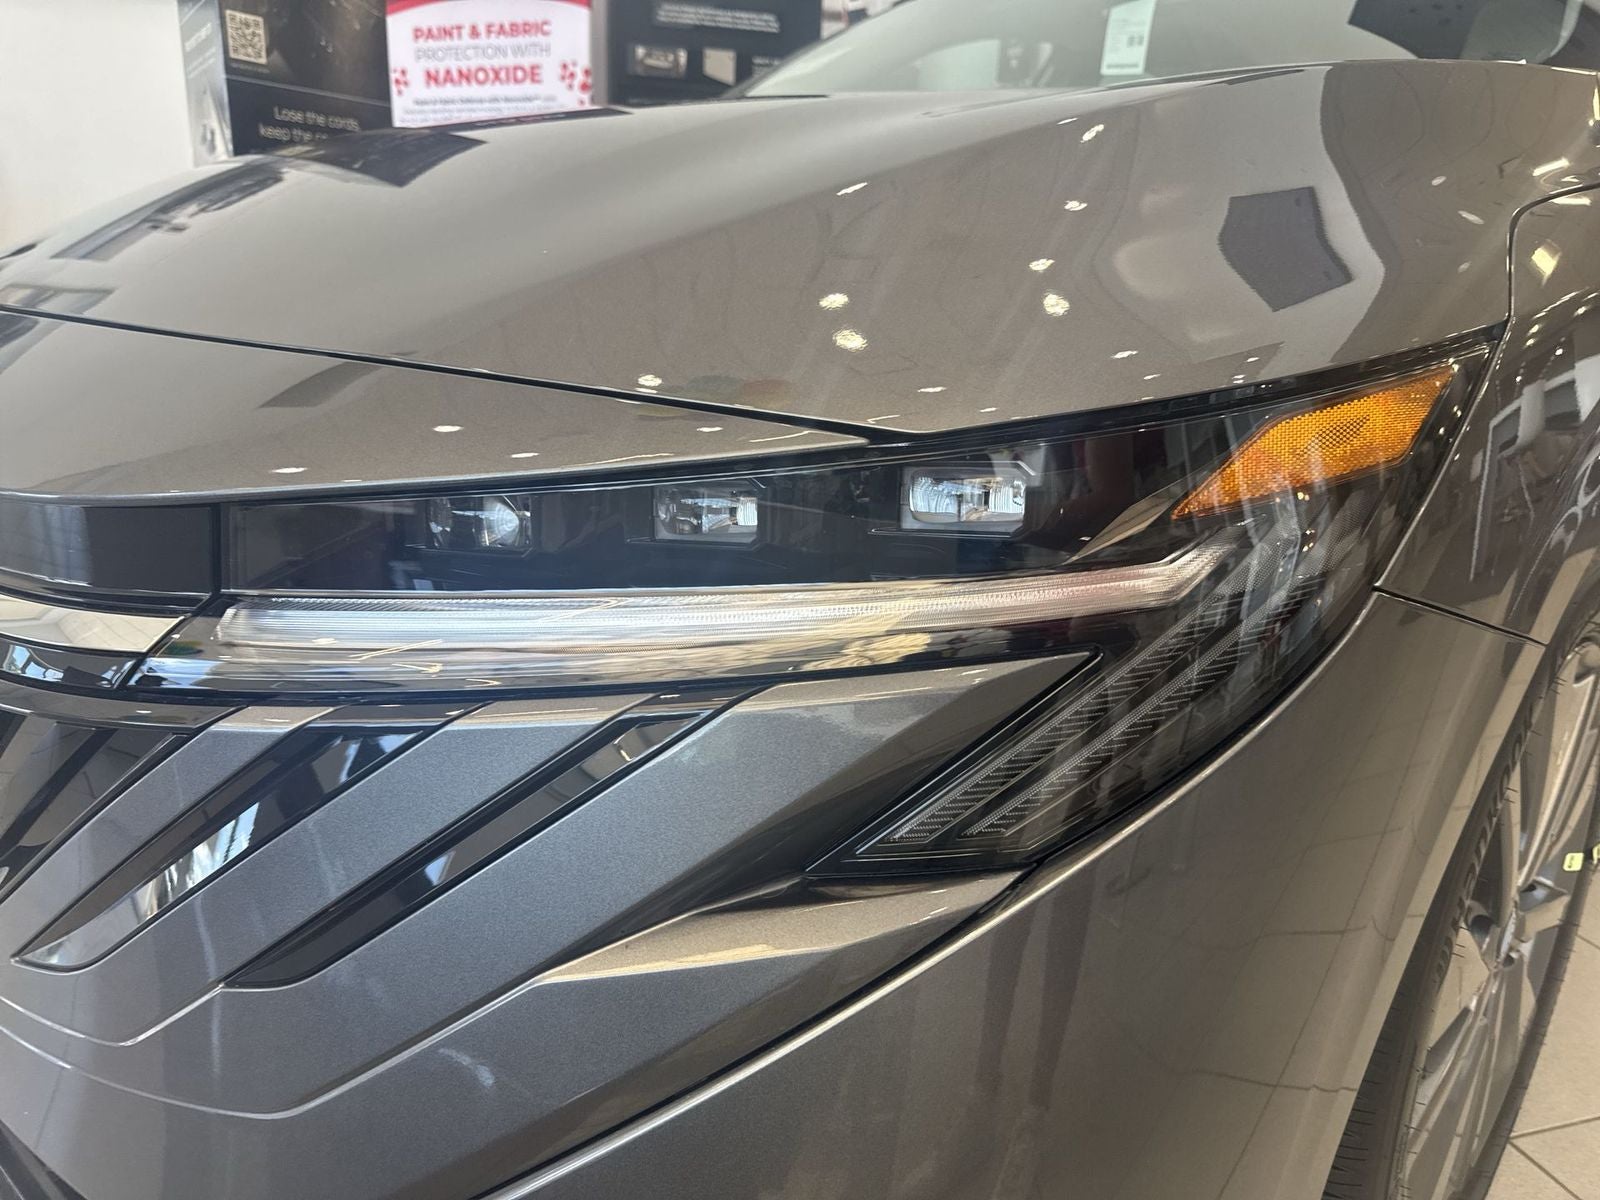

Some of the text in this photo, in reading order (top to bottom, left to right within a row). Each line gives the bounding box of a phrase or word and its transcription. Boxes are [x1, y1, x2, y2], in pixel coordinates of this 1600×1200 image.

[412, 19, 552, 43] PAINT & FABRIC
[414, 41, 551, 63] PROTECTION WITH
[424, 63, 543, 89] NANOXIDE
[273, 106, 304, 123] Lose
[305, 111, 327, 127] the
[258, 123, 291, 141] keep
[292, 128, 313, 142] the
